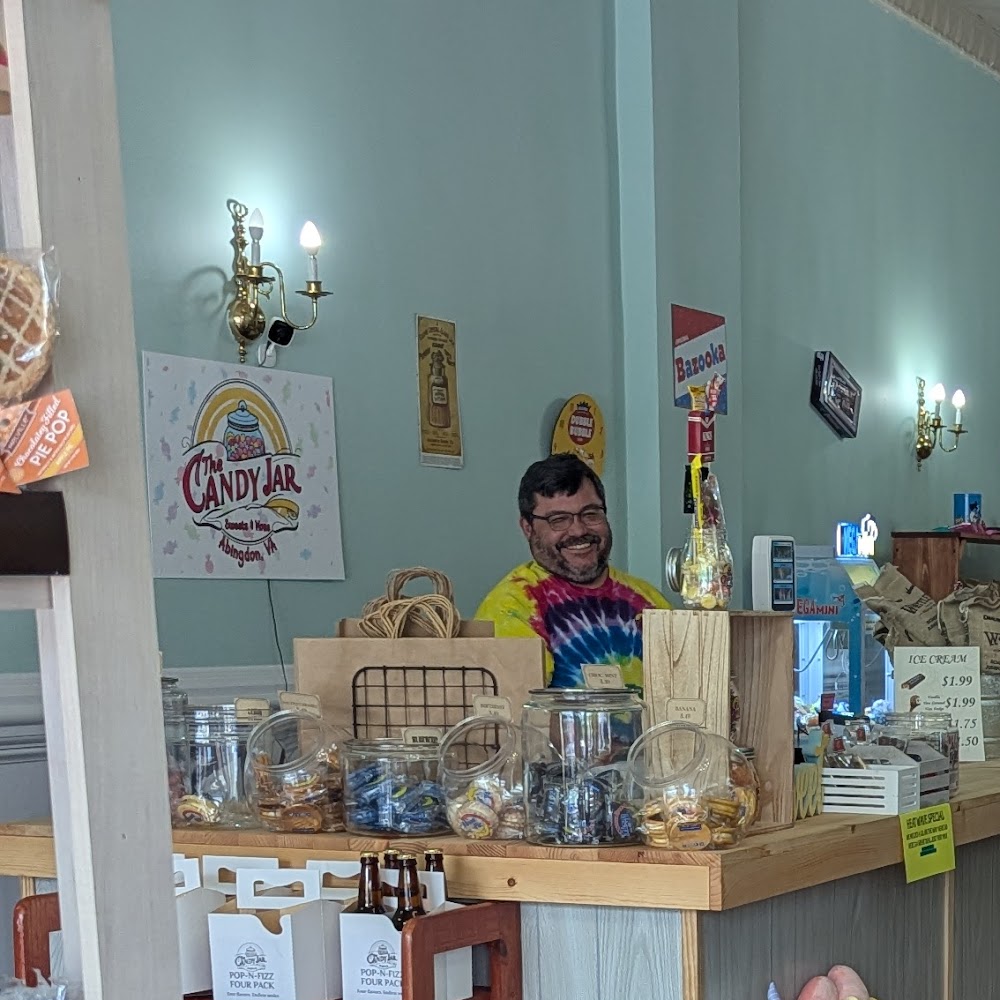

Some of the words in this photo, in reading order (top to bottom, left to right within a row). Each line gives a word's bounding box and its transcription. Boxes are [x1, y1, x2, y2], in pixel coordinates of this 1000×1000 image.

[675, 342, 726, 383] Bazooka
[29, 443, 53, 467] PIE
[45, 409, 71, 444] POP
[201, 453, 223, 476] The
[182, 449, 261, 513] CANDY
[263, 457, 302, 497] JAR
[796, 597, 839, 615] EGAMINI
[908, 654, 927, 665] ICE
[929, 654, 968, 665] CREAM
[942, 675, 973, 687] $1.99
[945, 697, 976, 708] $1.99
[229, 971, 275, 980] POP-N-FIZZ
[360, 968, 402, 978] POP-N-FIZ
[230, 981, 252, 989] FOUR
[361, 978, 383, 986] FOUR
[385, 979, 402, 987] PAC
